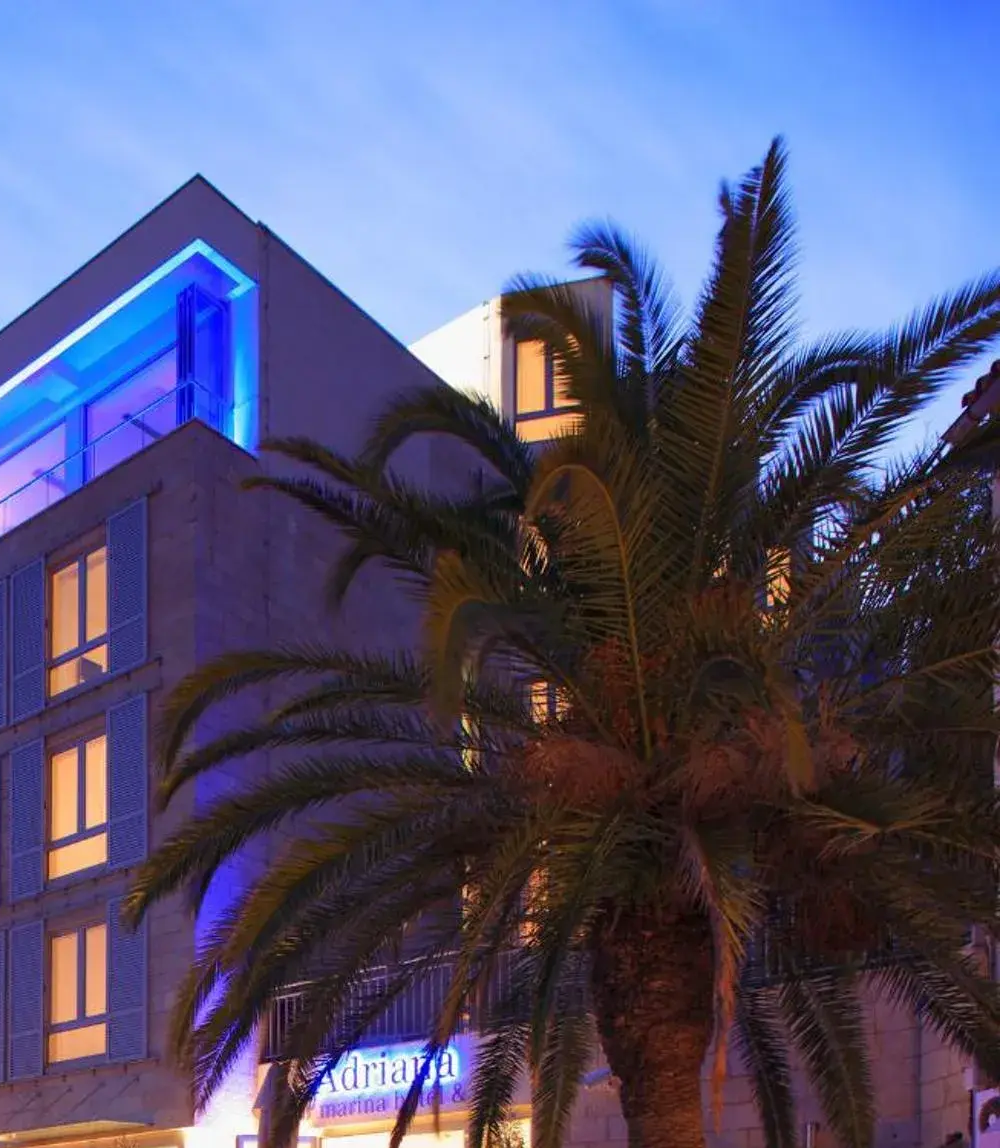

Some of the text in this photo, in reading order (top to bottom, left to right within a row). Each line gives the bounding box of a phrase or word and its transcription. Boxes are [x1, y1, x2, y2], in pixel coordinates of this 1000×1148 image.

[320, 1083, 465, 1118] marina htel &
